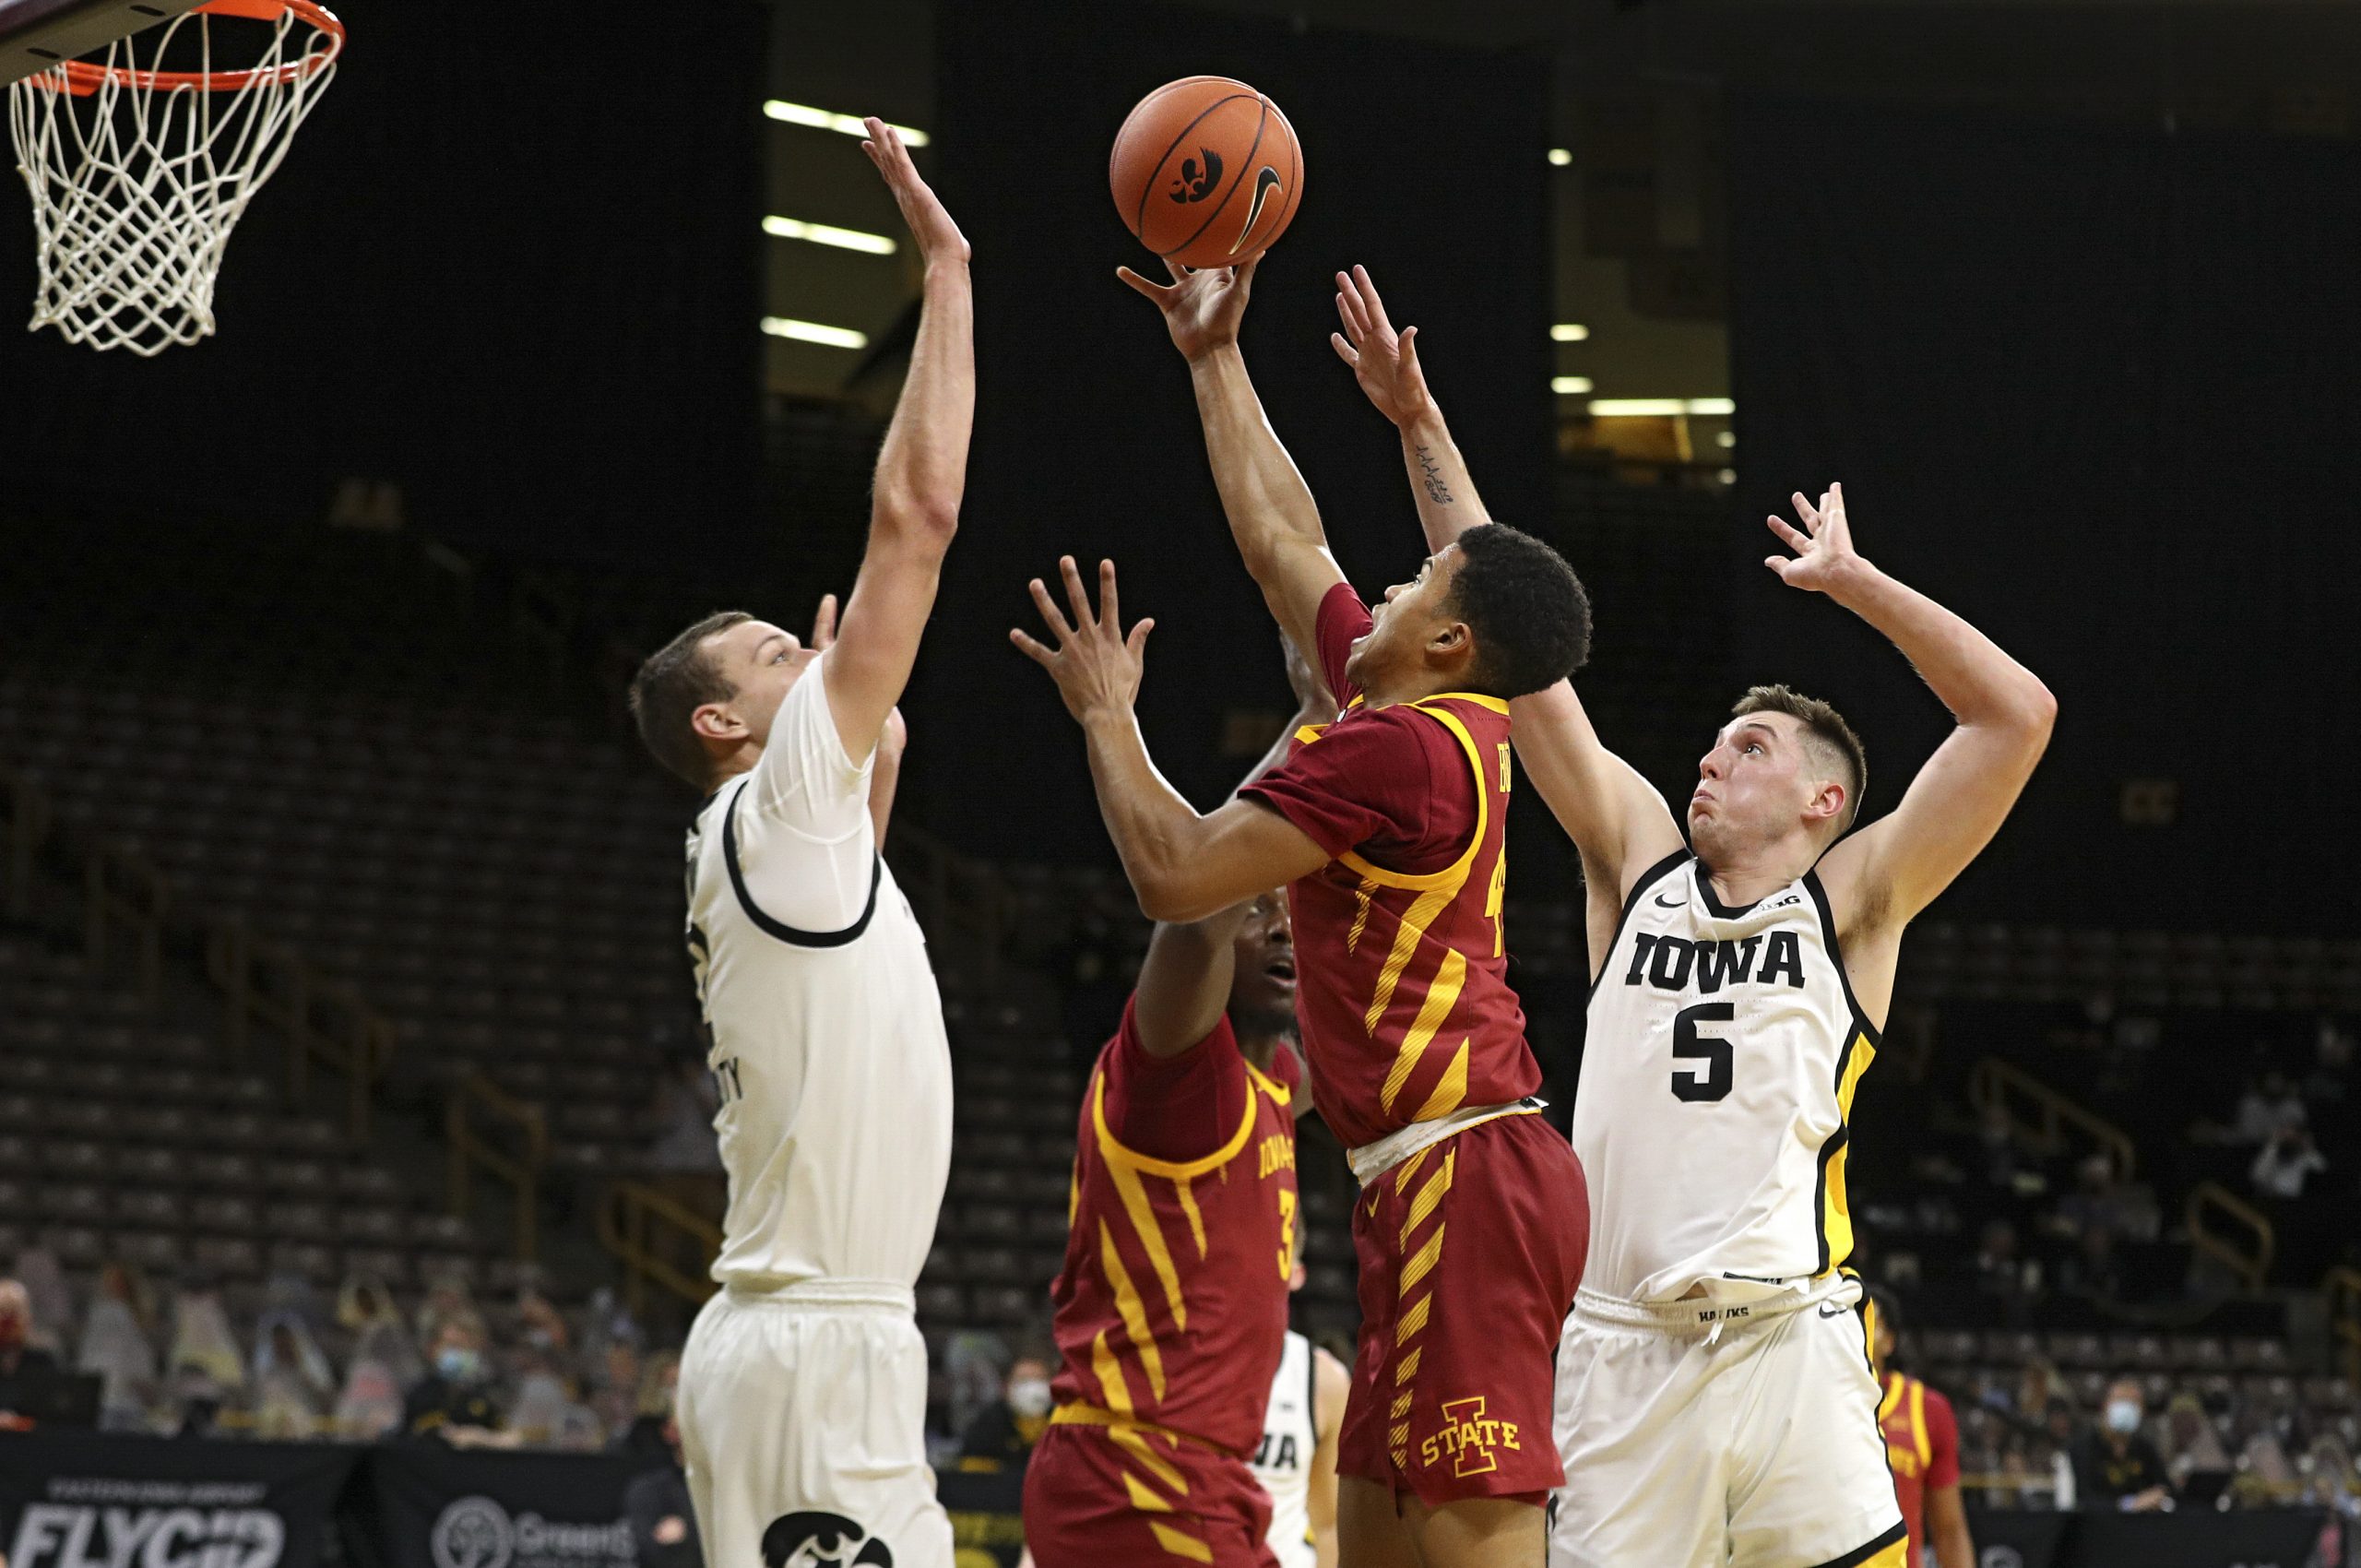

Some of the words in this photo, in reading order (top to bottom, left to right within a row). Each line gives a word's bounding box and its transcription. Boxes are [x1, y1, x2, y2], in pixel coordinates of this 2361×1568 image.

[1624, 932, 1806, 994] IOWA
[1671, 1003, 1735, 1102] 5
[1421, 1419, 1521, 1468] STATE
